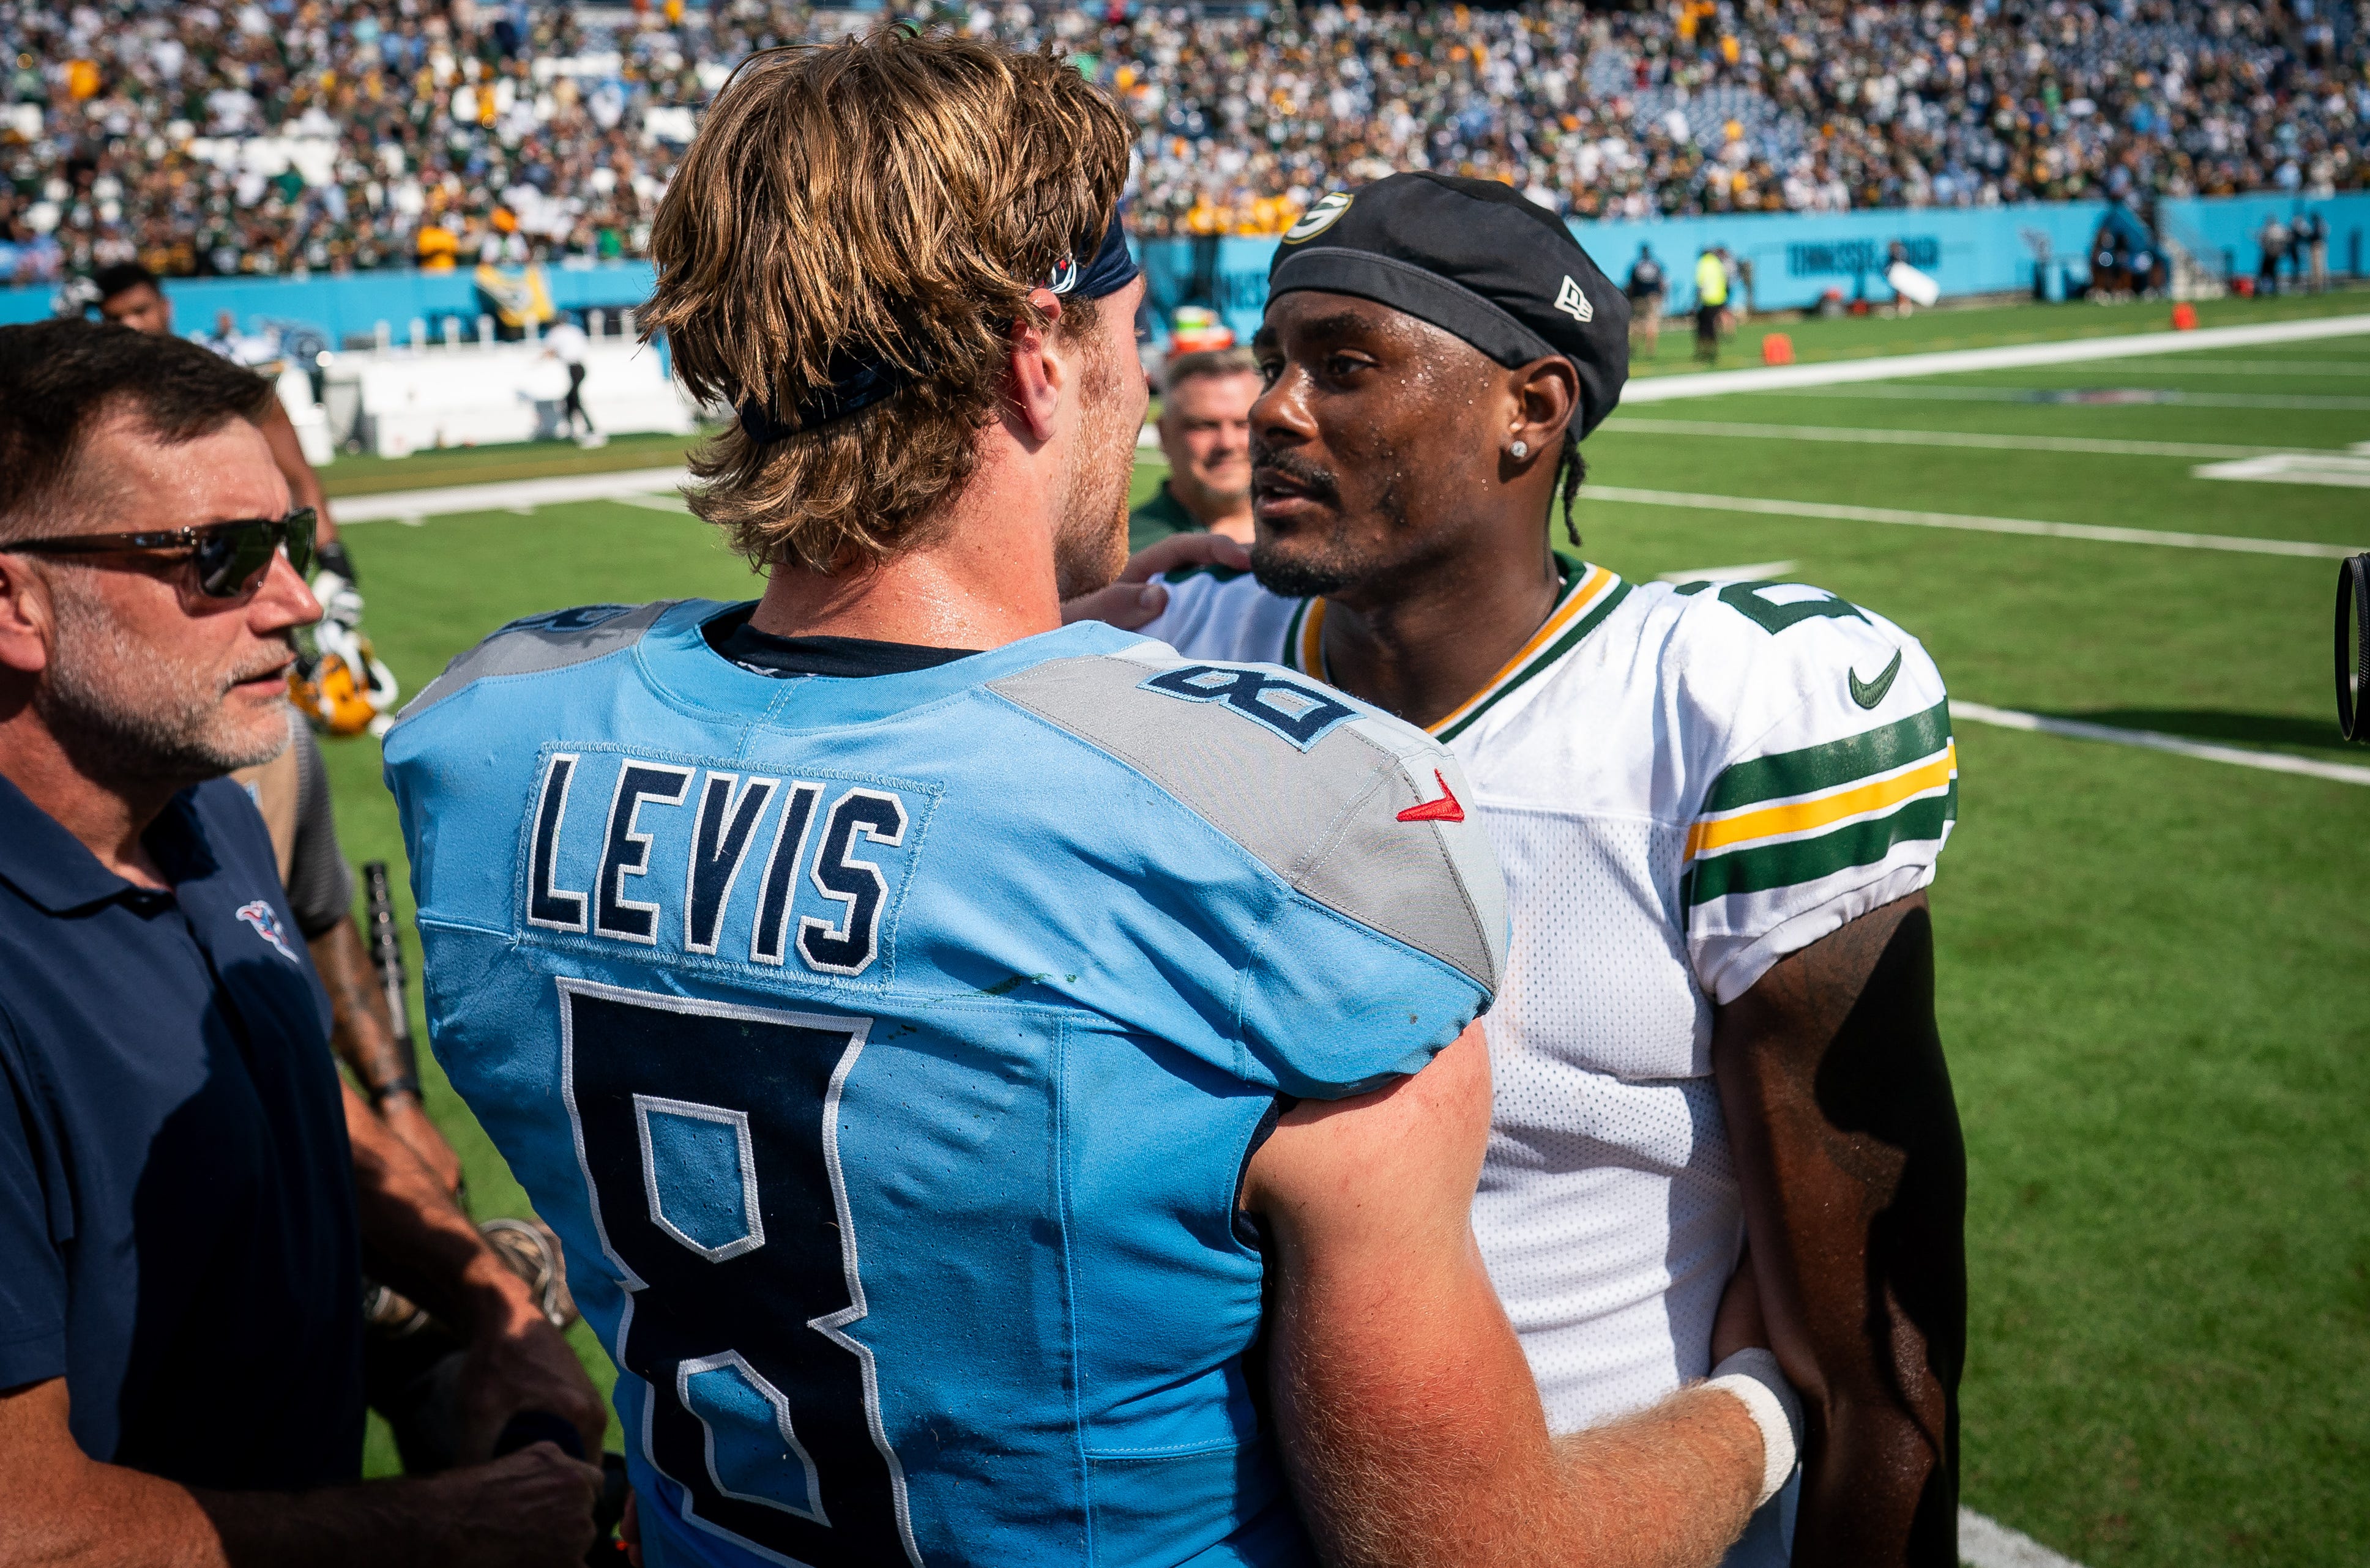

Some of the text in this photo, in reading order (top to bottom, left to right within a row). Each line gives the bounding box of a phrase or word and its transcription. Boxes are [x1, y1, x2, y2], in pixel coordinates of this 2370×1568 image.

[1136, 665, 1367, 754] 8
[526, 752, 909, 976] LEVIS
[554, 976, 924, 1568] 8
